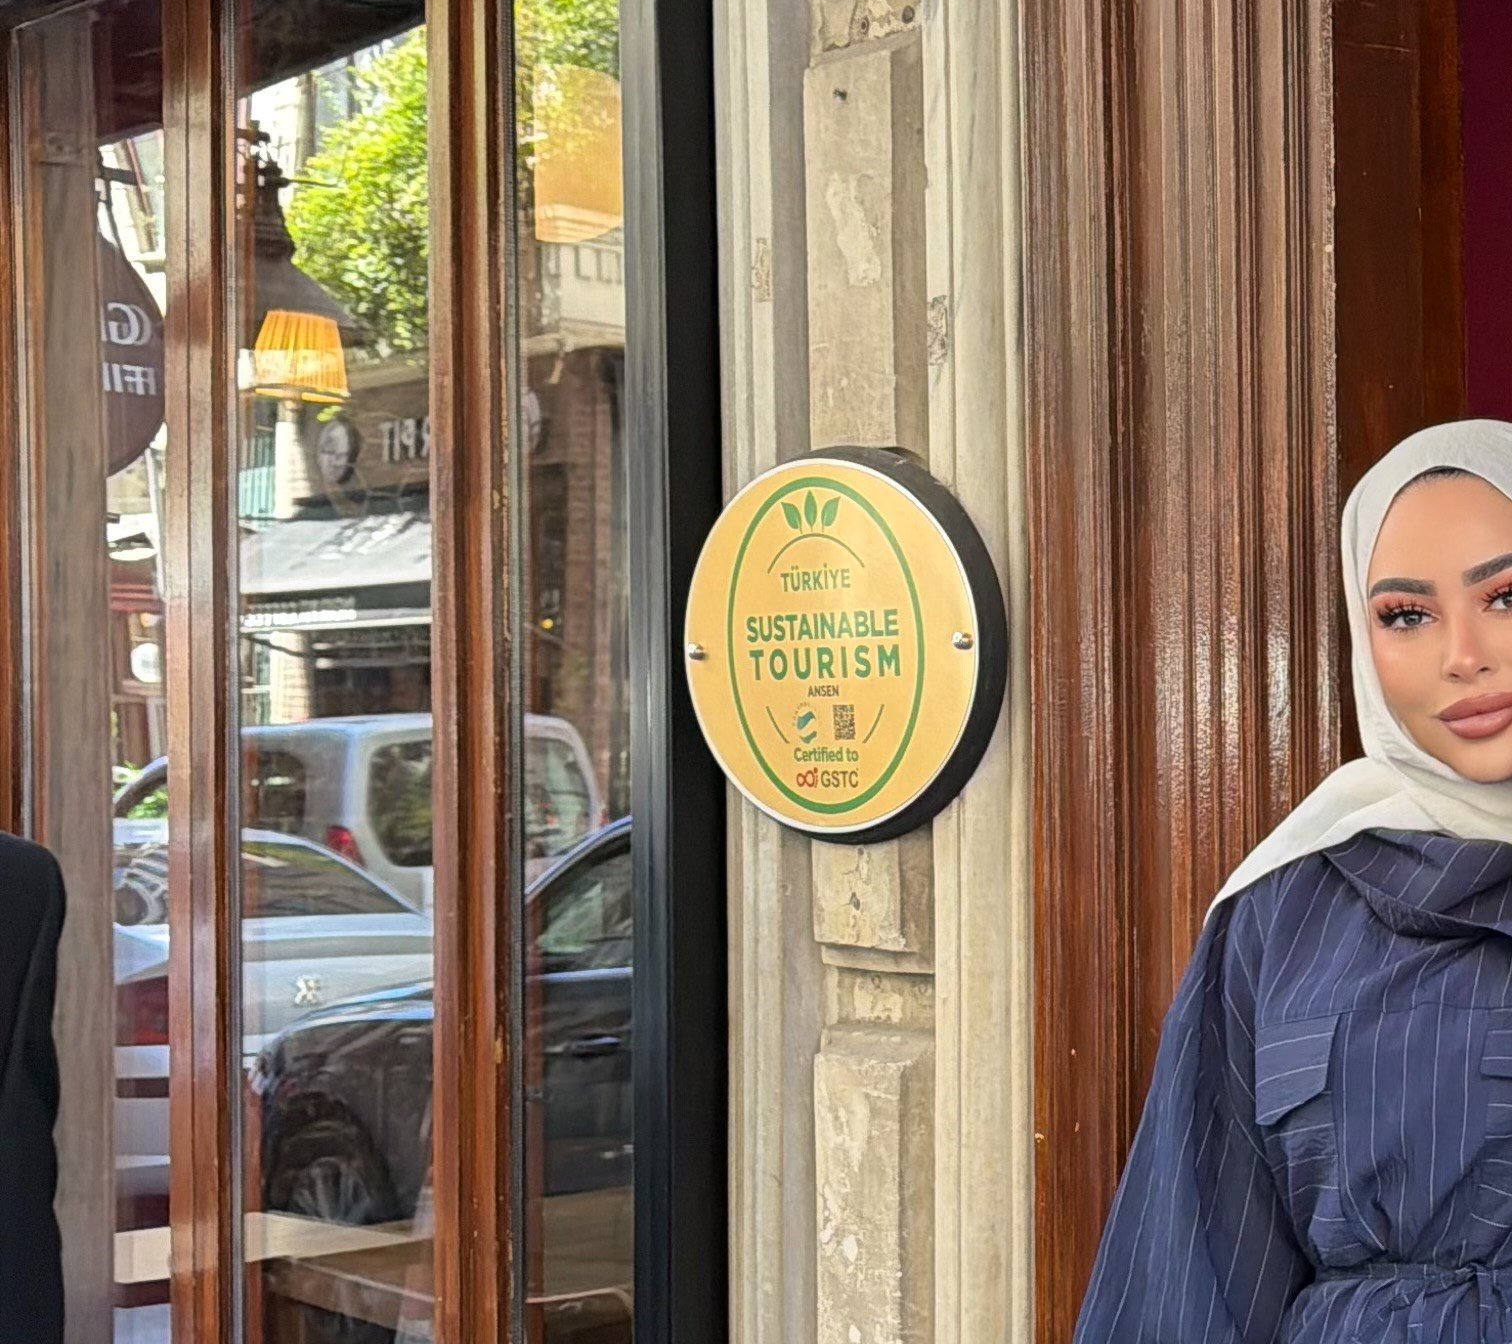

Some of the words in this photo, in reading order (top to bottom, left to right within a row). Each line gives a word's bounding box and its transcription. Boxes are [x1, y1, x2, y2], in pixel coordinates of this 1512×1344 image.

[780, 563, 851, 593] TÜRKİYE
[746, 608, 899, 643] SUSTAINABLE
[749, 643, 901, 681] TOURISM
[807, 684, 840, 698] ANSEN
[793, 746, 844, 762] Certified
[846, 747, 860, 762] to
[820, 768, 860, 789] GSTC
